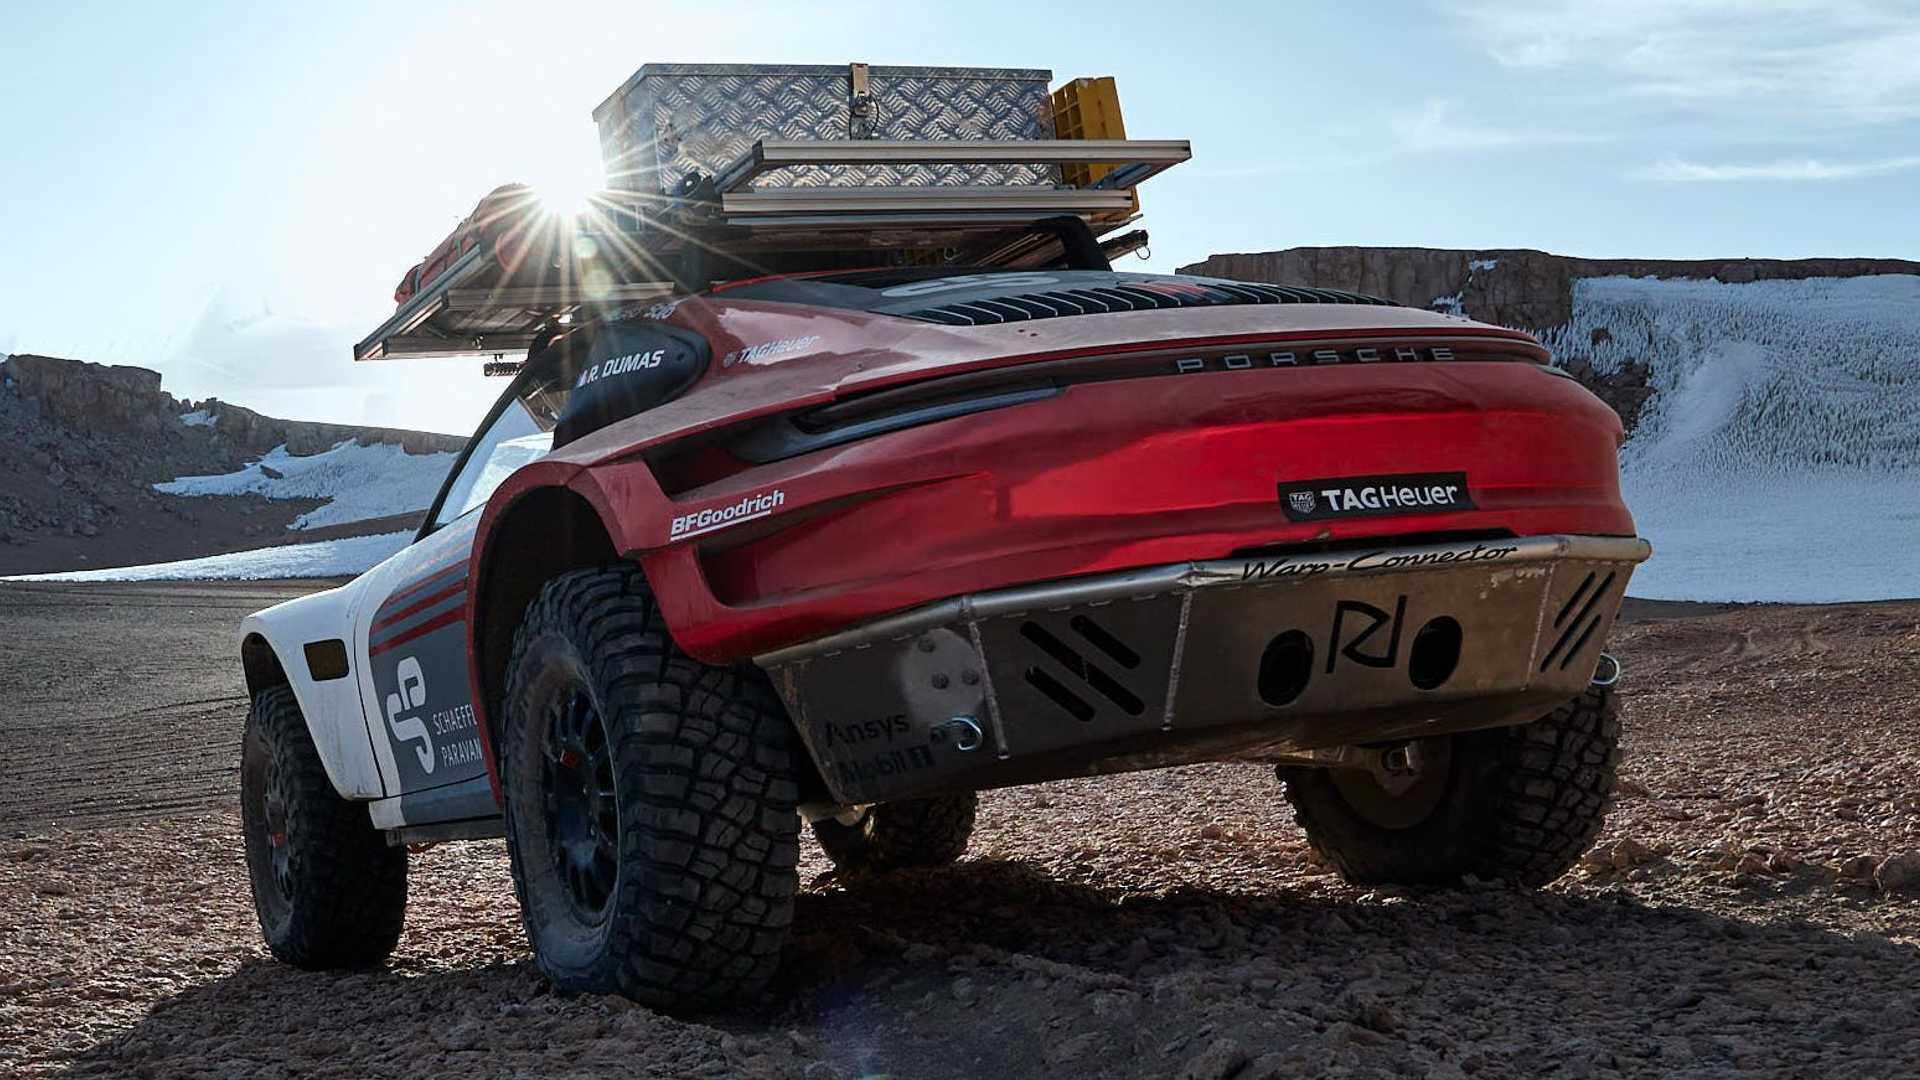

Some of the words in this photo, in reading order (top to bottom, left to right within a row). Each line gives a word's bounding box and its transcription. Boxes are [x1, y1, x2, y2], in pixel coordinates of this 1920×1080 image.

[586, 365, 599, 383] R.
[601, 349, 665, 378] DUMAS
[1176, 347, 1456, 374] PORSCHE
[671, 489, 785, 538] BFGoodrich
[1321, 485, 1458, 512] TAGHeuer
[1242, 544, 1518, 581] Warp-Connector
[827, 713, 909, 747] Ansys
[441, 737, 484, 769] PARAVAN
